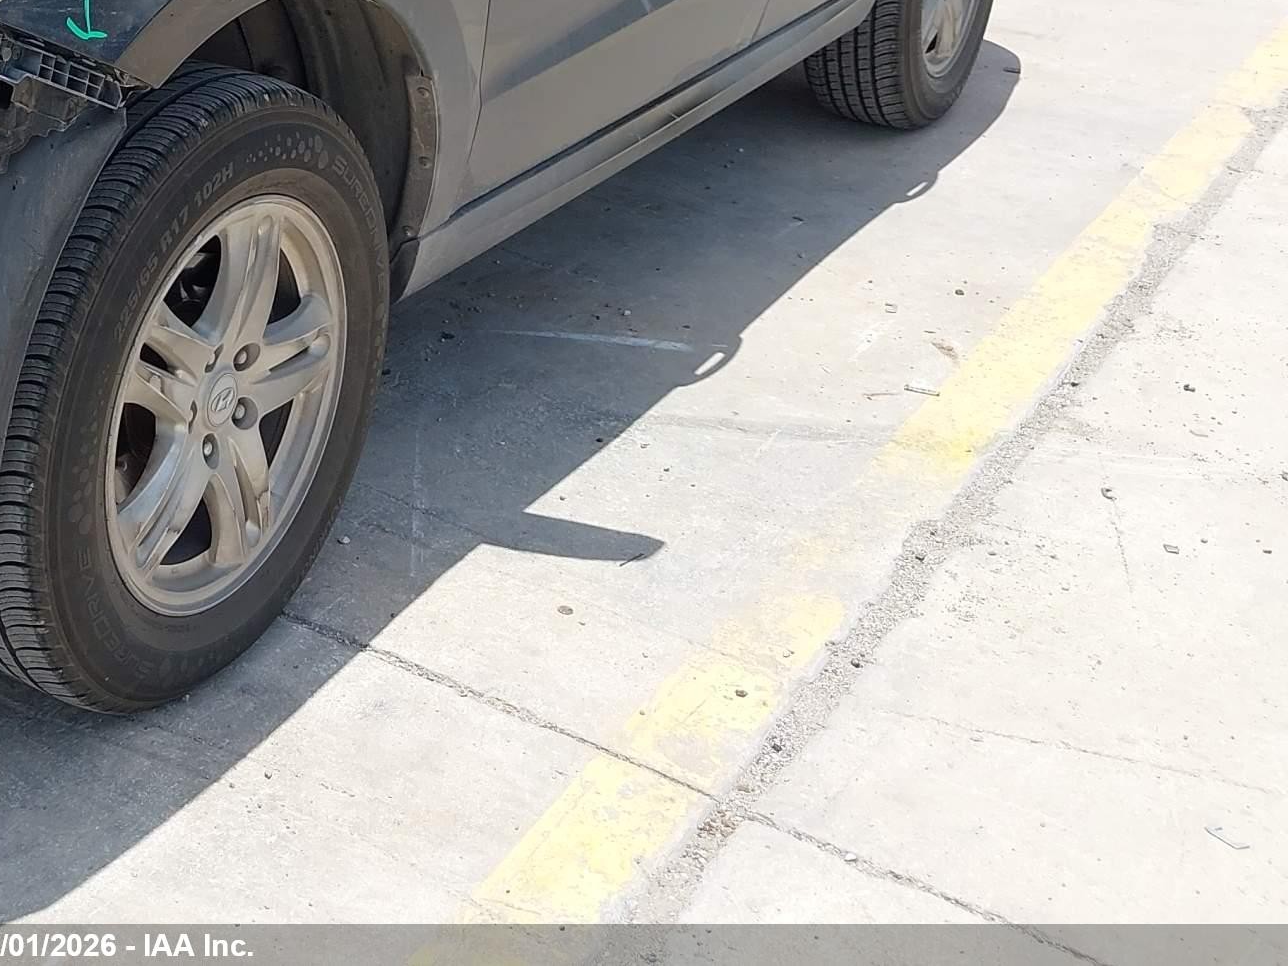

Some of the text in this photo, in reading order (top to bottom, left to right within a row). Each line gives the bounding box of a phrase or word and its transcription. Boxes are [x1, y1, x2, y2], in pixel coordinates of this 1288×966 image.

[114, 161, 235, 342] 225/65 R17 102H
